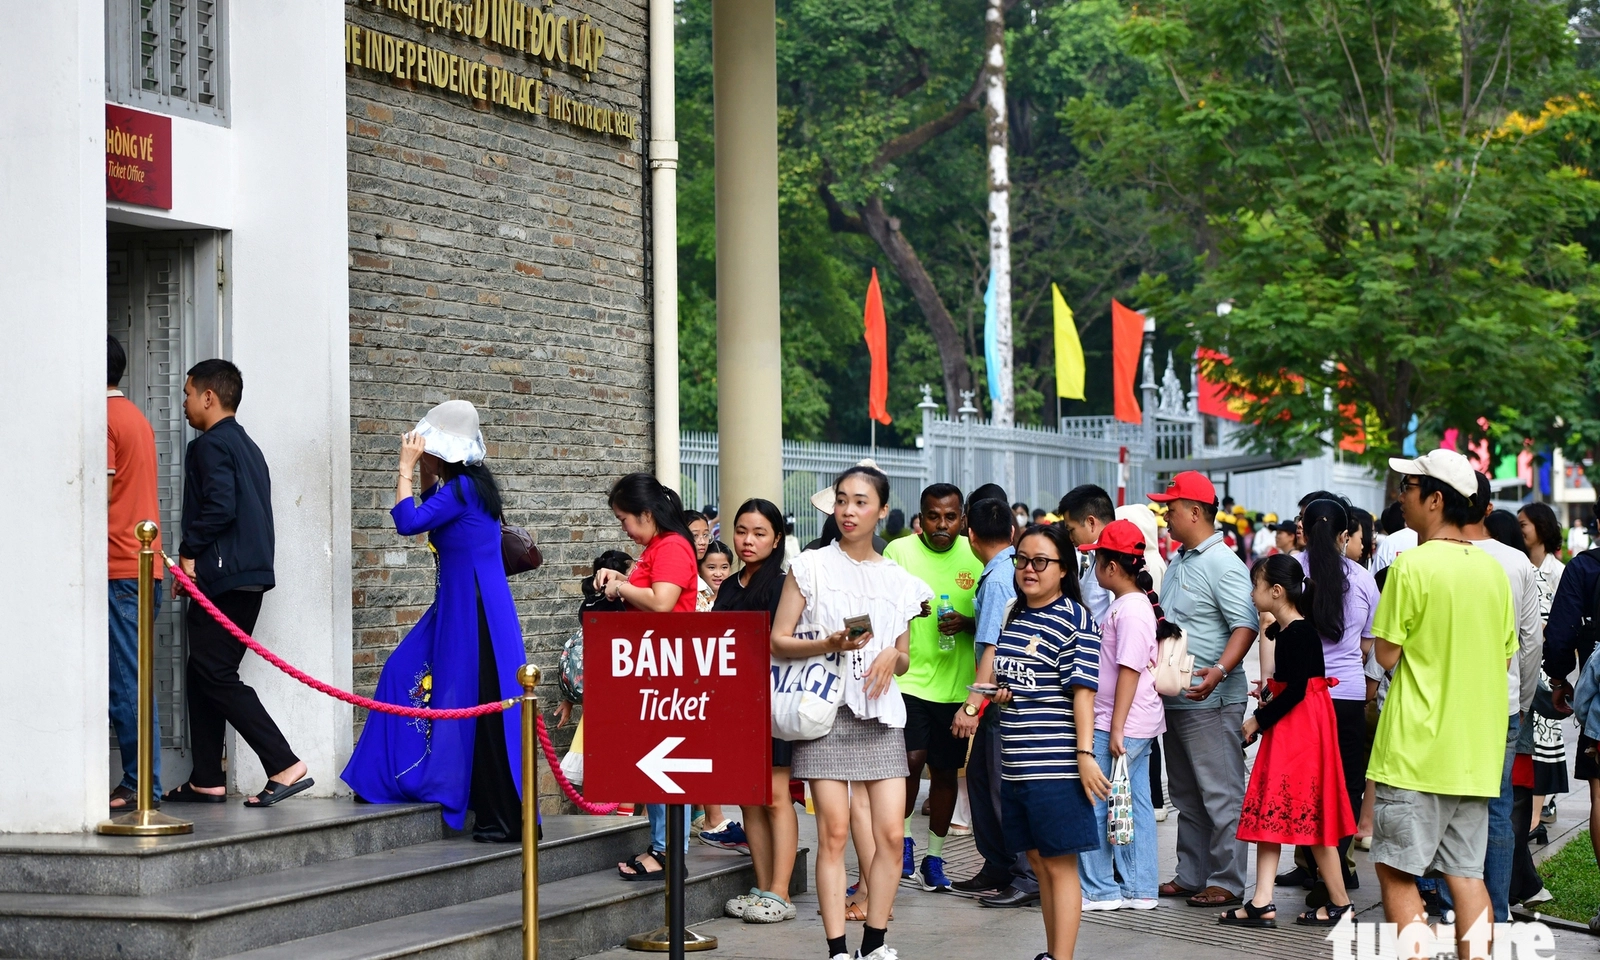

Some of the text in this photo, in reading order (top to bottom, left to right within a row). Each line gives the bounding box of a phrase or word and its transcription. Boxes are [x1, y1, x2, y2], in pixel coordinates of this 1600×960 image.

[475, 0, 525, 51] DINH
[573, 14, 606, 82] LẬP
[366, 30, 487, 101] INDEPENDENCE
[492, 66, 543, 115] PALACE
[553, 94, 614, 133] HISTORICAL
[140, 134, 154, 162] VÉ
[108, 160, 146, 183] Ticket Office
[611, 628, 738, 678] BÁN VÉ
[639, 688, 710, 721] Ticket
